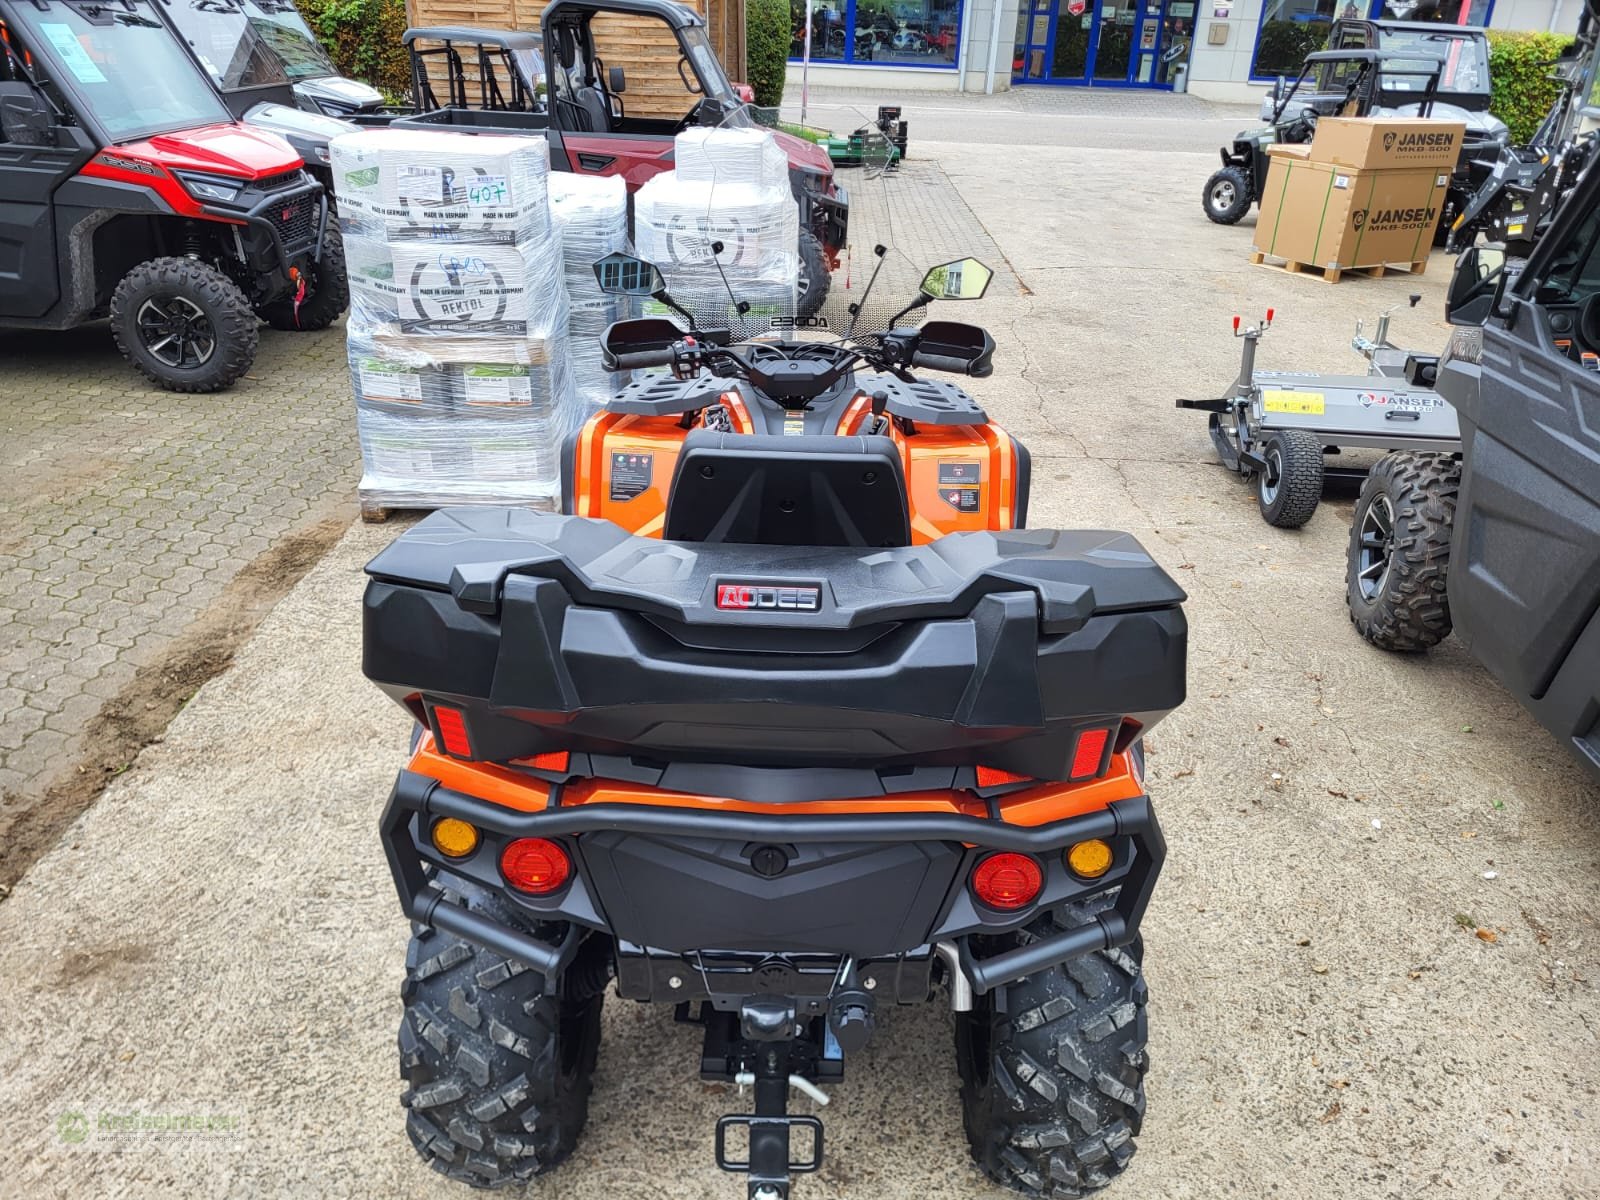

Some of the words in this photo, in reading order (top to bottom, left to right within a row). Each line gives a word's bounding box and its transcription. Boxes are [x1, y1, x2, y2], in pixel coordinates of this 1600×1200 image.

[1398, 133, 1454, 146] JANSEN
[1371, 208, 1436, 224] JANSEN
[441, 298, 485, 315] REKTOL
[1377, 395, 1444, 408] JANSEN
[720, 587, 817, 609] AODES
